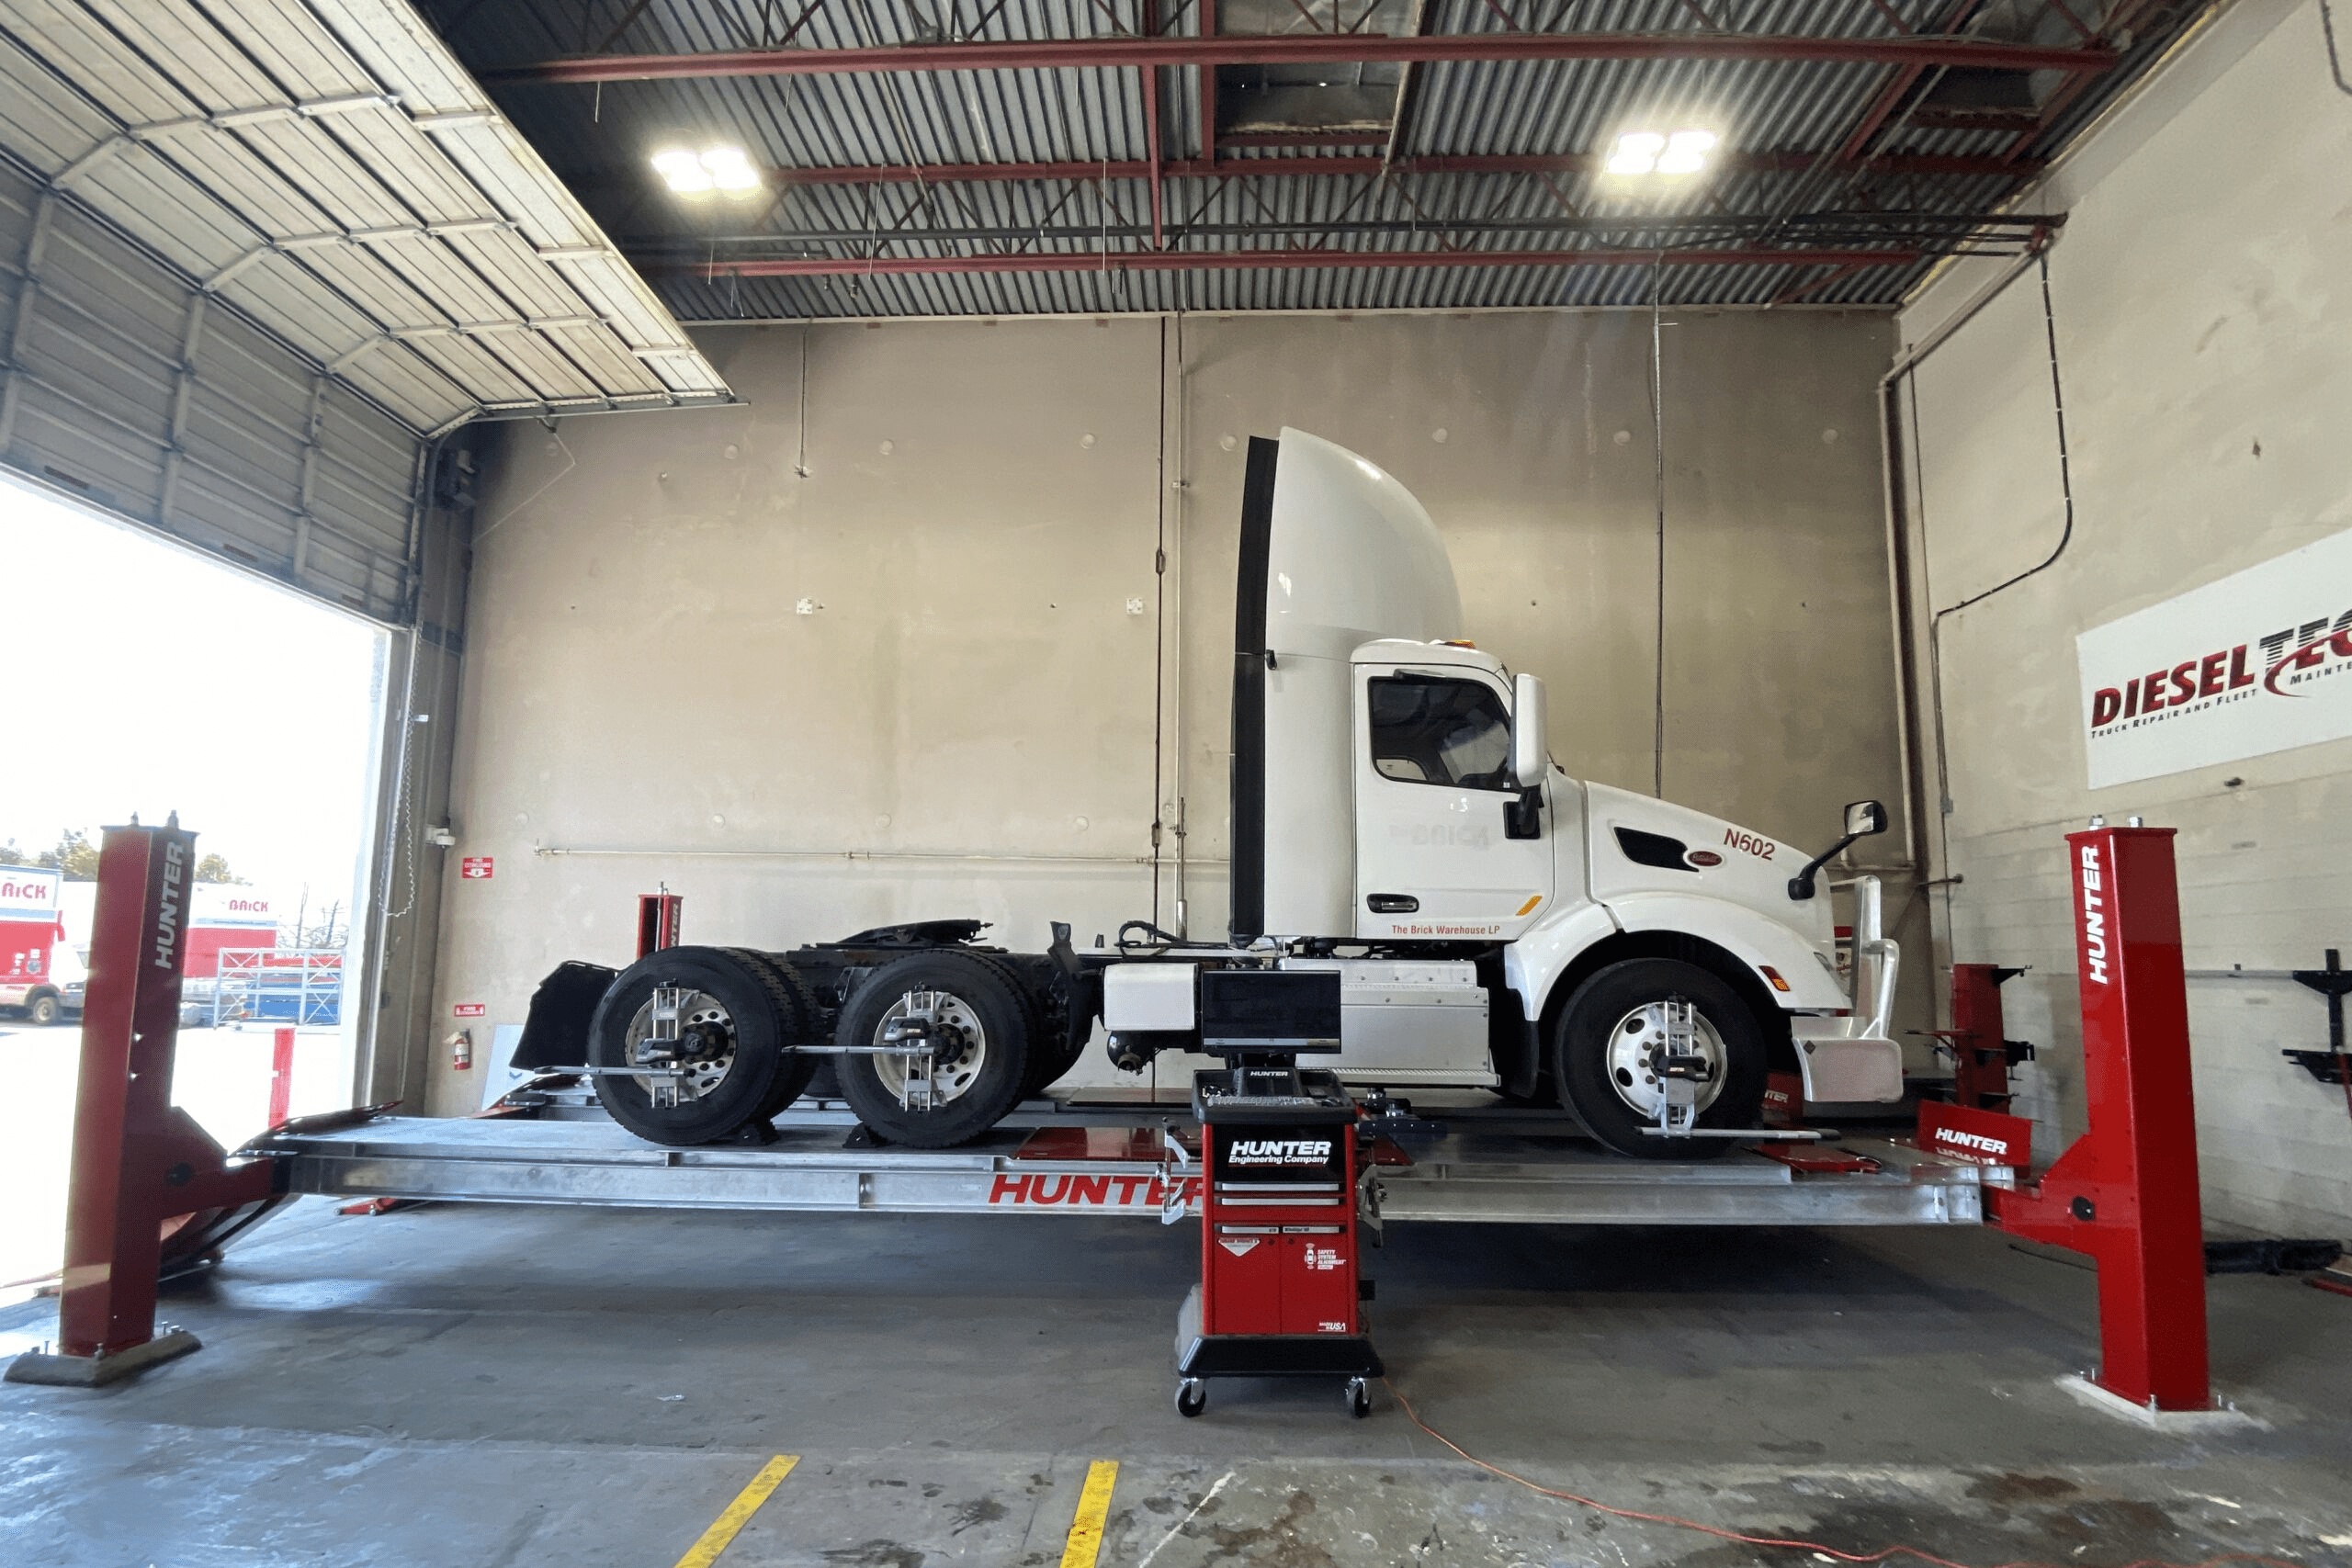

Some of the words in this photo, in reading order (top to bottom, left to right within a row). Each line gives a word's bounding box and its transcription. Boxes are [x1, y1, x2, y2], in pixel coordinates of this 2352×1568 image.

[2091, 644, 2256, 728] DIESEL
[2091, 723, 2128, 739] TRUCK
[2132, 710, 2179, 728] REPAIR
[2185, 701, 2211, 715] AND
[2216, 688, 2257, 706] FLEET
[1724, 828, 1775, 861] N602
[154, 841, 184, 970] HUNTER
[2081, 844, 2109, 985] HUNTER
[1392, 924, 1408, 935] The
[1410, 924, 1433, 935] Brick
[1436, 924, 1486, 935] Warehouse
[1488, 924, 1500, 935] LP
[1230, 1141, 1332, 1156] HUNTER
[1935, 1127, 2007, 1155] HUNTER
[1228, 1155, 1283, 1165] Engineering
[1283, 1155, 1329, 1165] Company
[1330, 1322, 1346, 1331] USA
